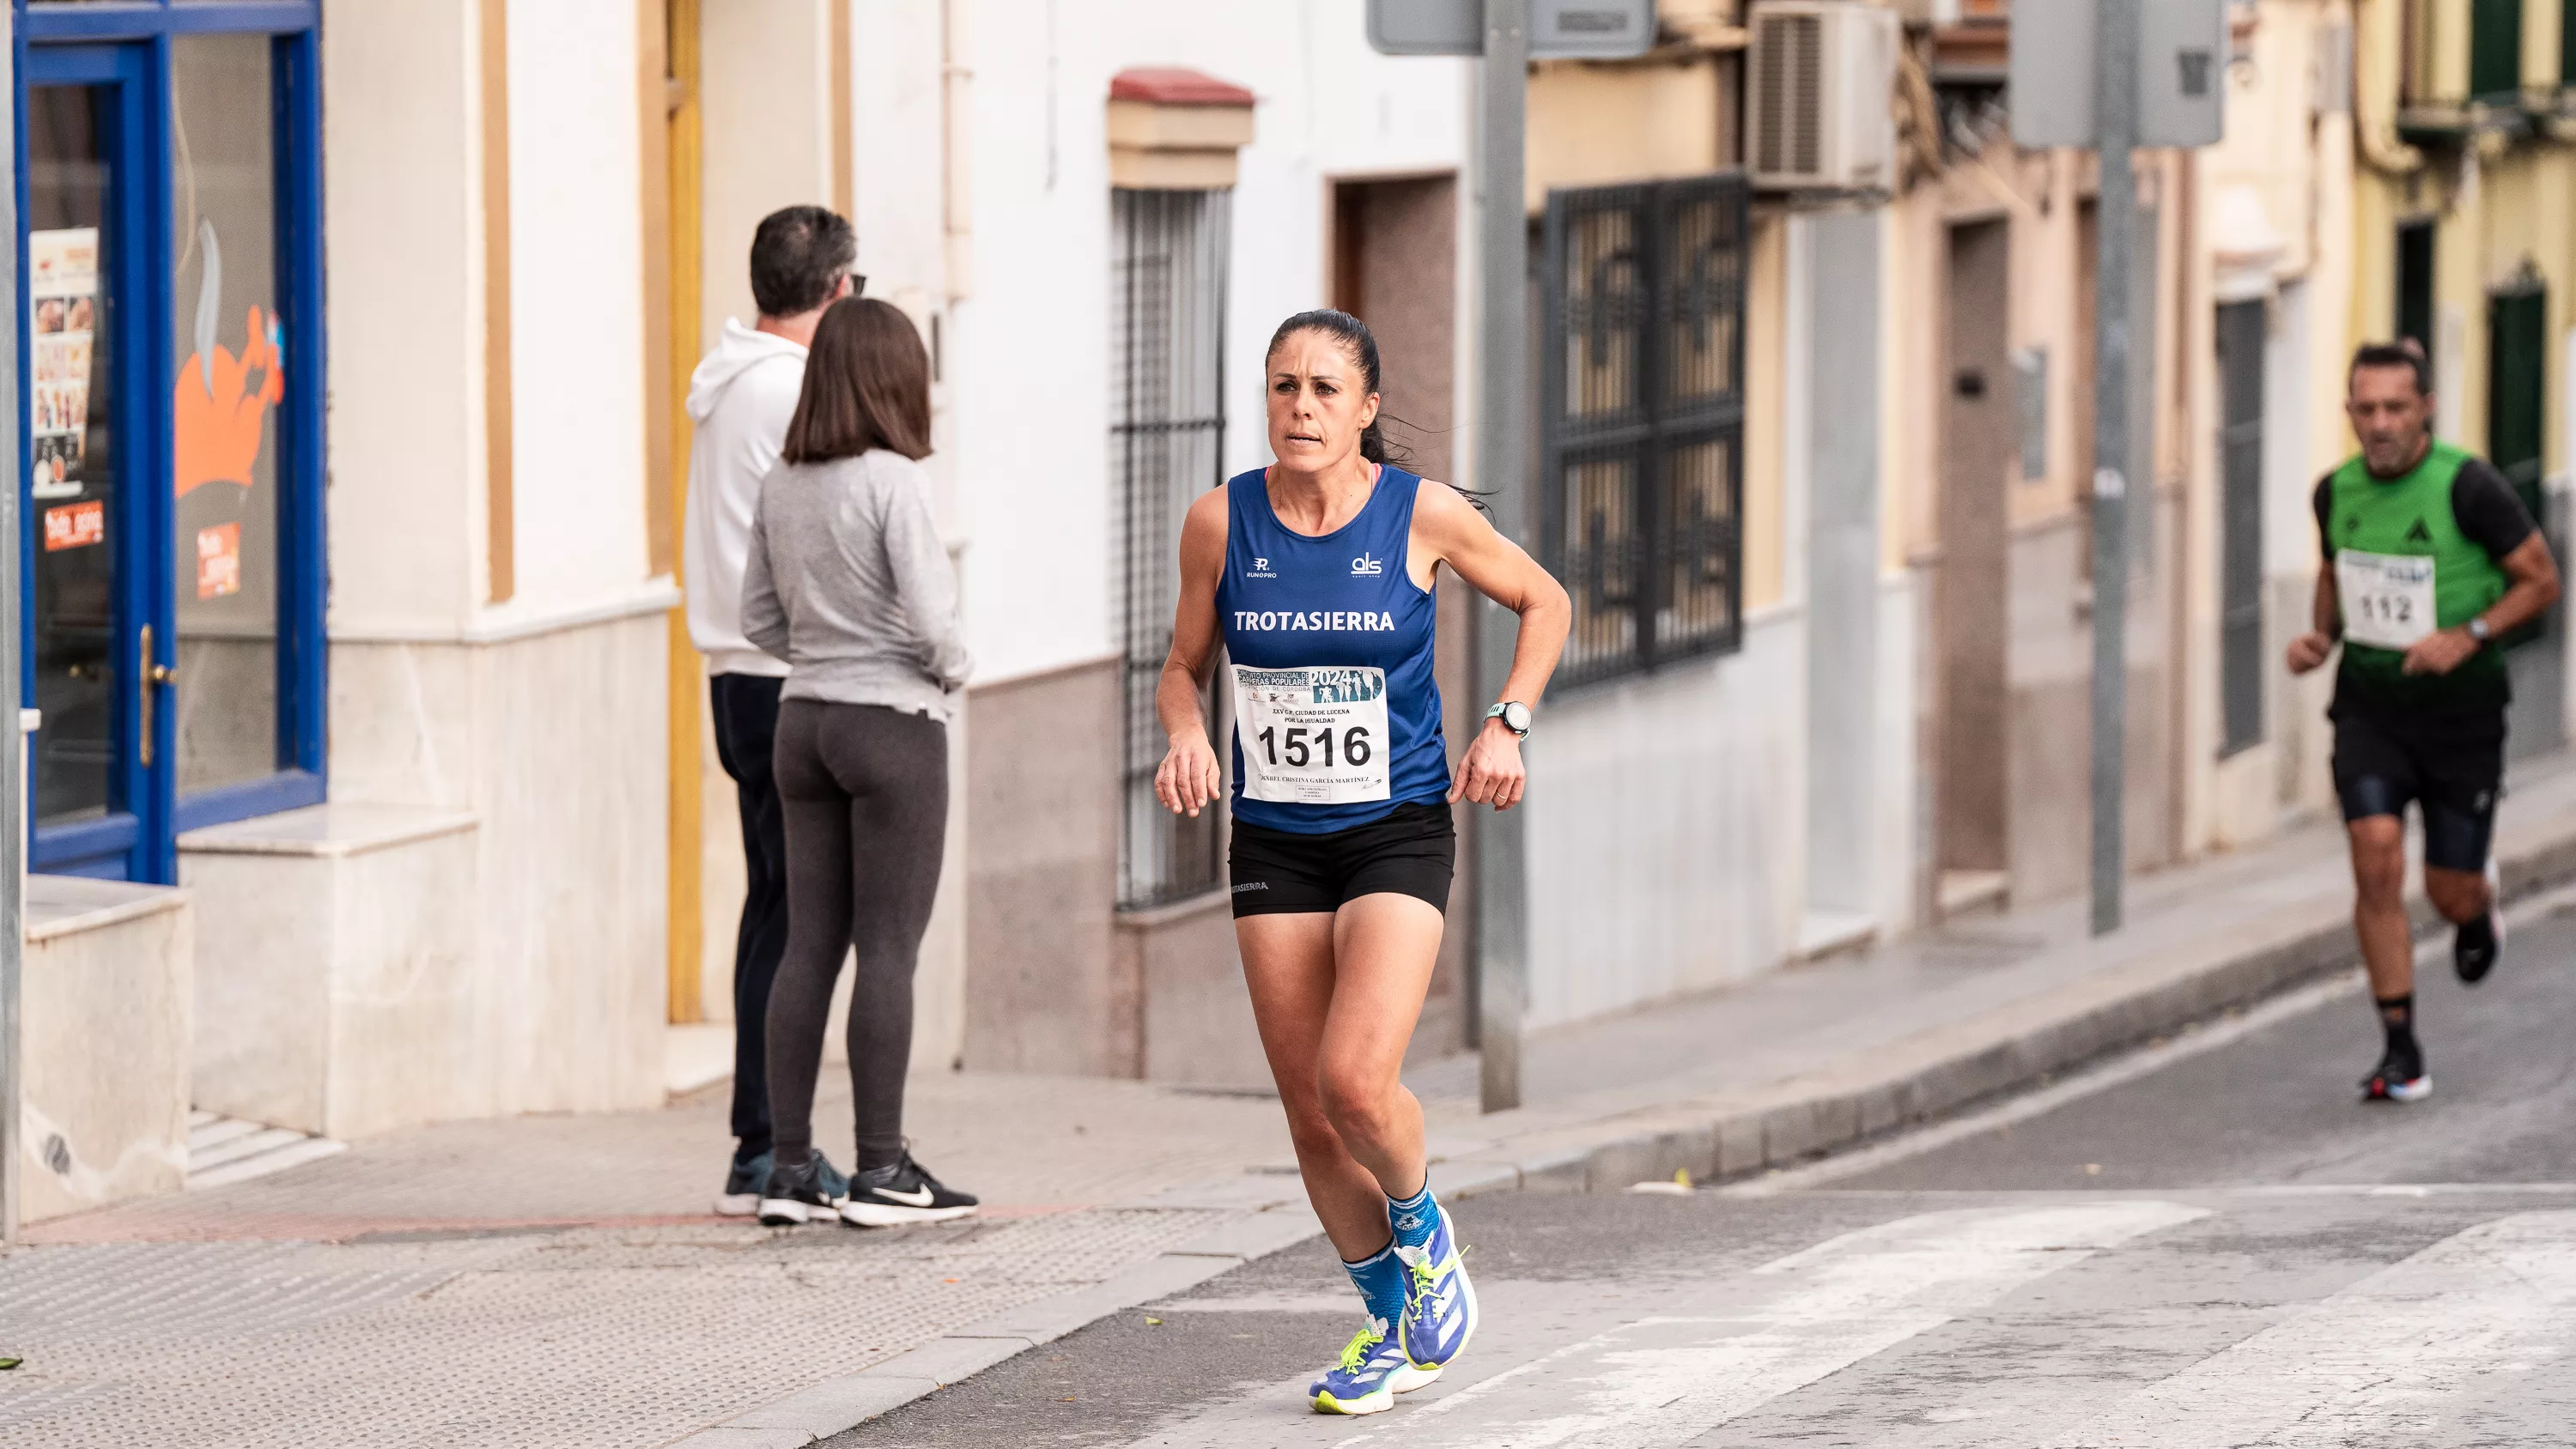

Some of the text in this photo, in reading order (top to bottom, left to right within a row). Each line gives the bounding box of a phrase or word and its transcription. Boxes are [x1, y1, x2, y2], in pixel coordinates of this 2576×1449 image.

[1351, 552, 1382, 574] als
[2360, 595, 2412, 621] 112
[1234, 611, 1395, 631] TROTASIERRA
[1310, 670, 1352, 686] 2024
[1259, 726, 1370, 767] 1516
